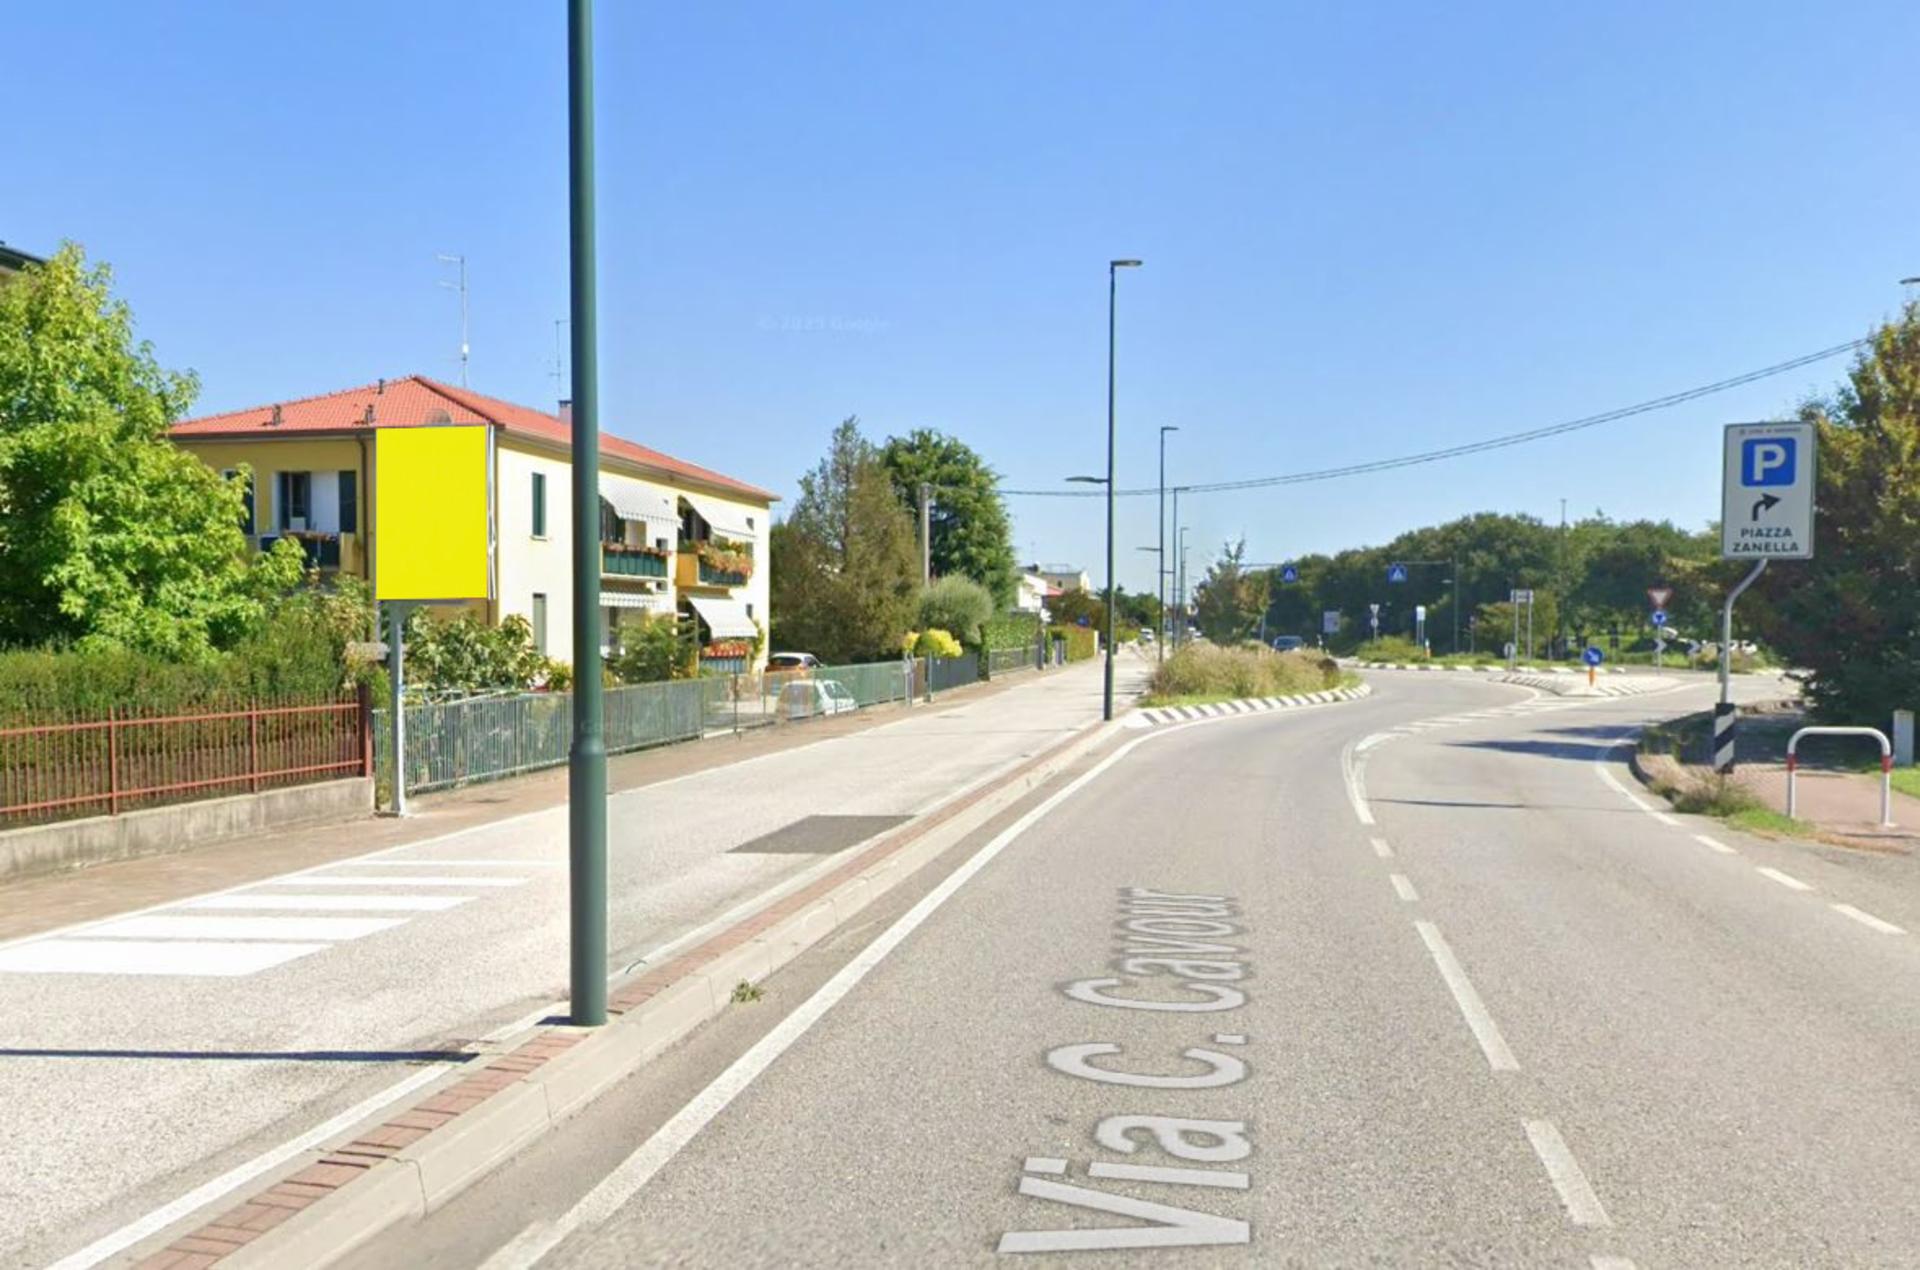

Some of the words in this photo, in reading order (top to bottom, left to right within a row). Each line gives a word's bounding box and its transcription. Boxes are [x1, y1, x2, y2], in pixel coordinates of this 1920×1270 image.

[1753, 444, 1786, 481] P
[1740, 527, 1793, 539] PIAZZA
[1732, 542, 1799, 553] ZANELLA
